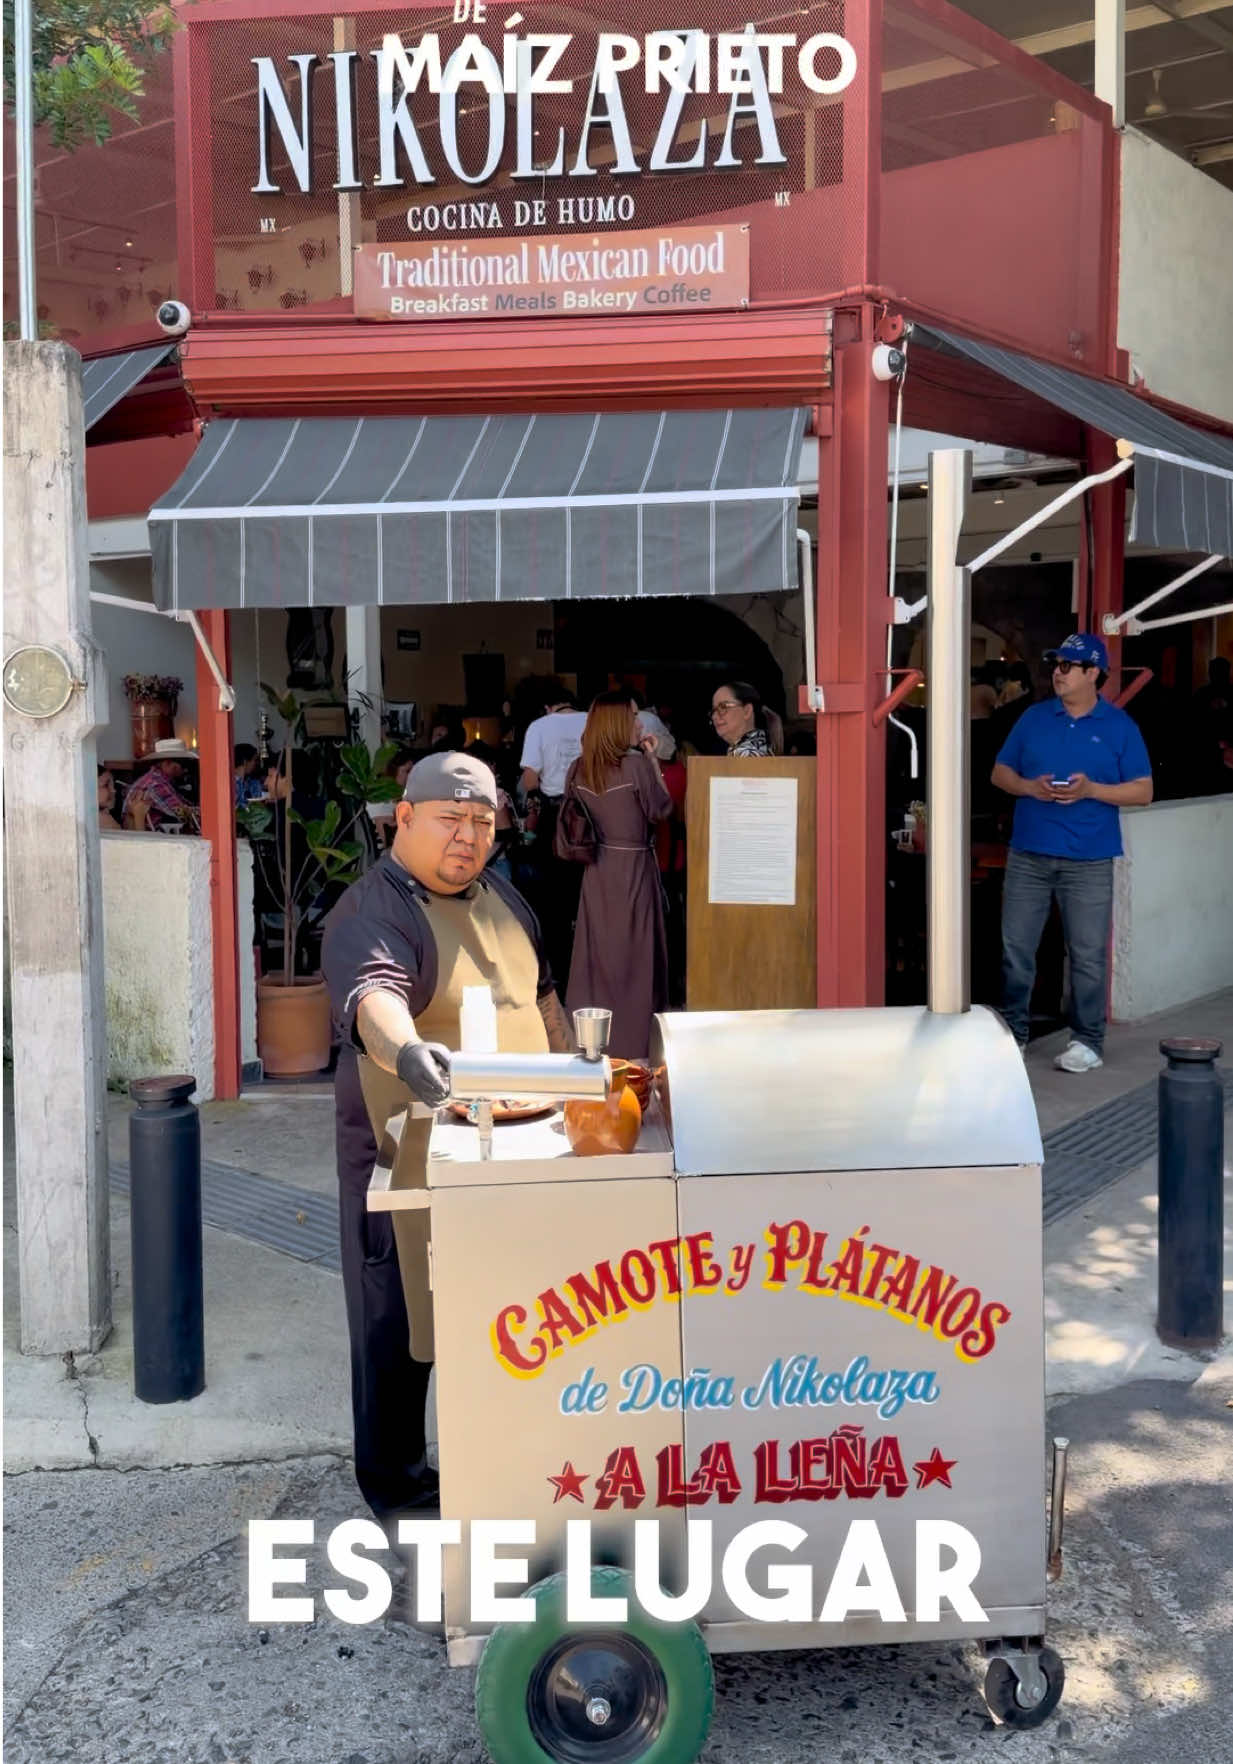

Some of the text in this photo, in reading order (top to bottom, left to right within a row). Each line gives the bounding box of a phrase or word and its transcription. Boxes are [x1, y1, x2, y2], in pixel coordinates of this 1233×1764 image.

[250, 23, 787, 193] NIKOLAZA
[260, 217, 276, 233] MX
[407, 194, 636, 231] COCINA DE HUMO
[775, 191, 791, 207] MX
[376, 232, 725, 289] Traditional Mexican Food
[390, 282, 712, 314] Breakfast Meals Bakery Coffee
[490, 1230, 724, 1380] CAMOTE
[765, 1219, 1012, 1364] PLÁTANOS
[560, 1354, 941, 1421] de Doña Nikolaza
[594, 1423, 909, 1511] A LA LEÑA
